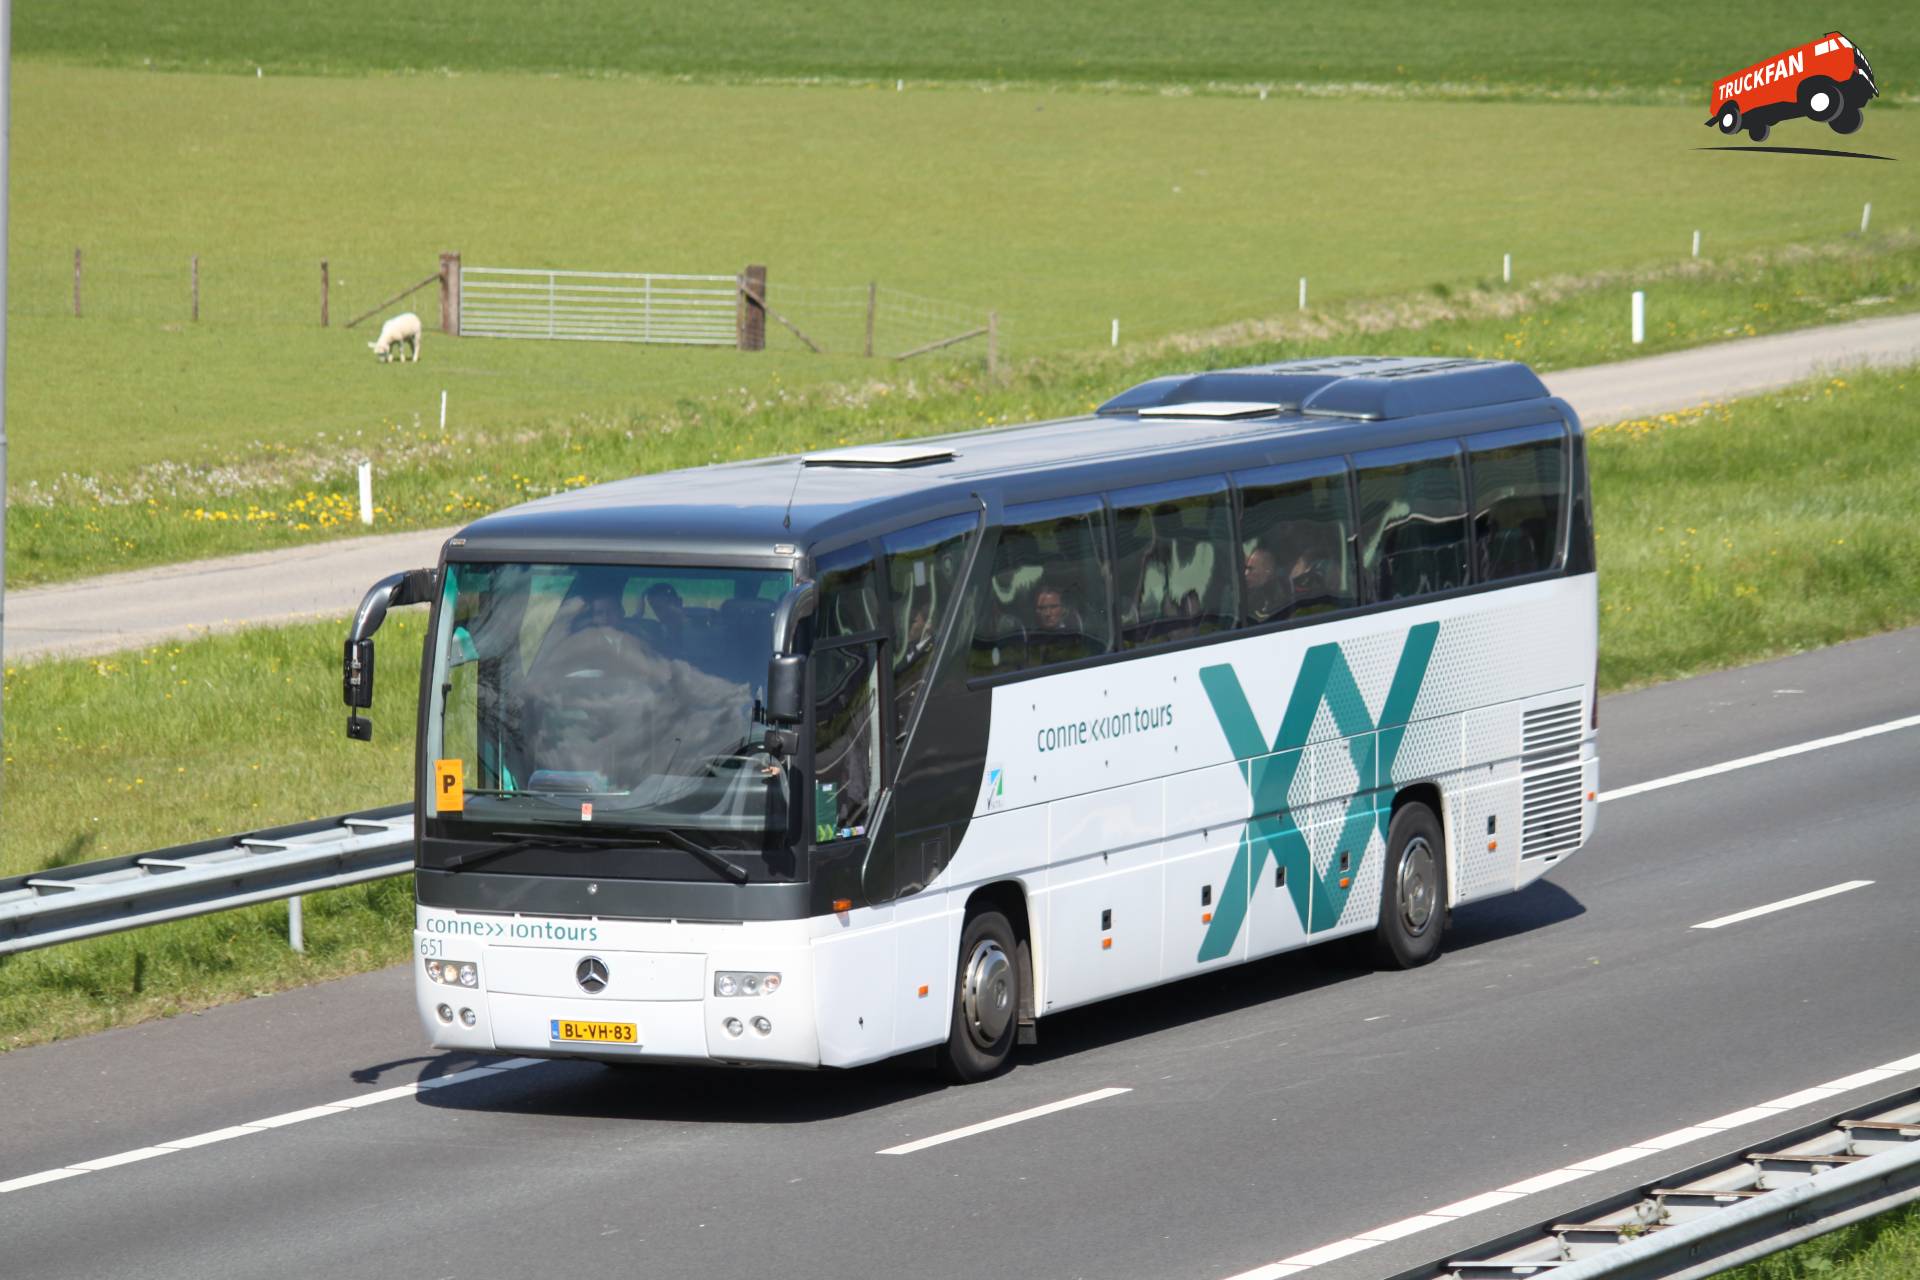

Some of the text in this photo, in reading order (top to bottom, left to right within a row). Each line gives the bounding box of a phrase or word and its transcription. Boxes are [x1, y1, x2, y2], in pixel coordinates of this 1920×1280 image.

[442, 774, 456, 794] P
[420, 937, 443, 957] 651
[564, 1023, 632, 1041] BL-VH-83
